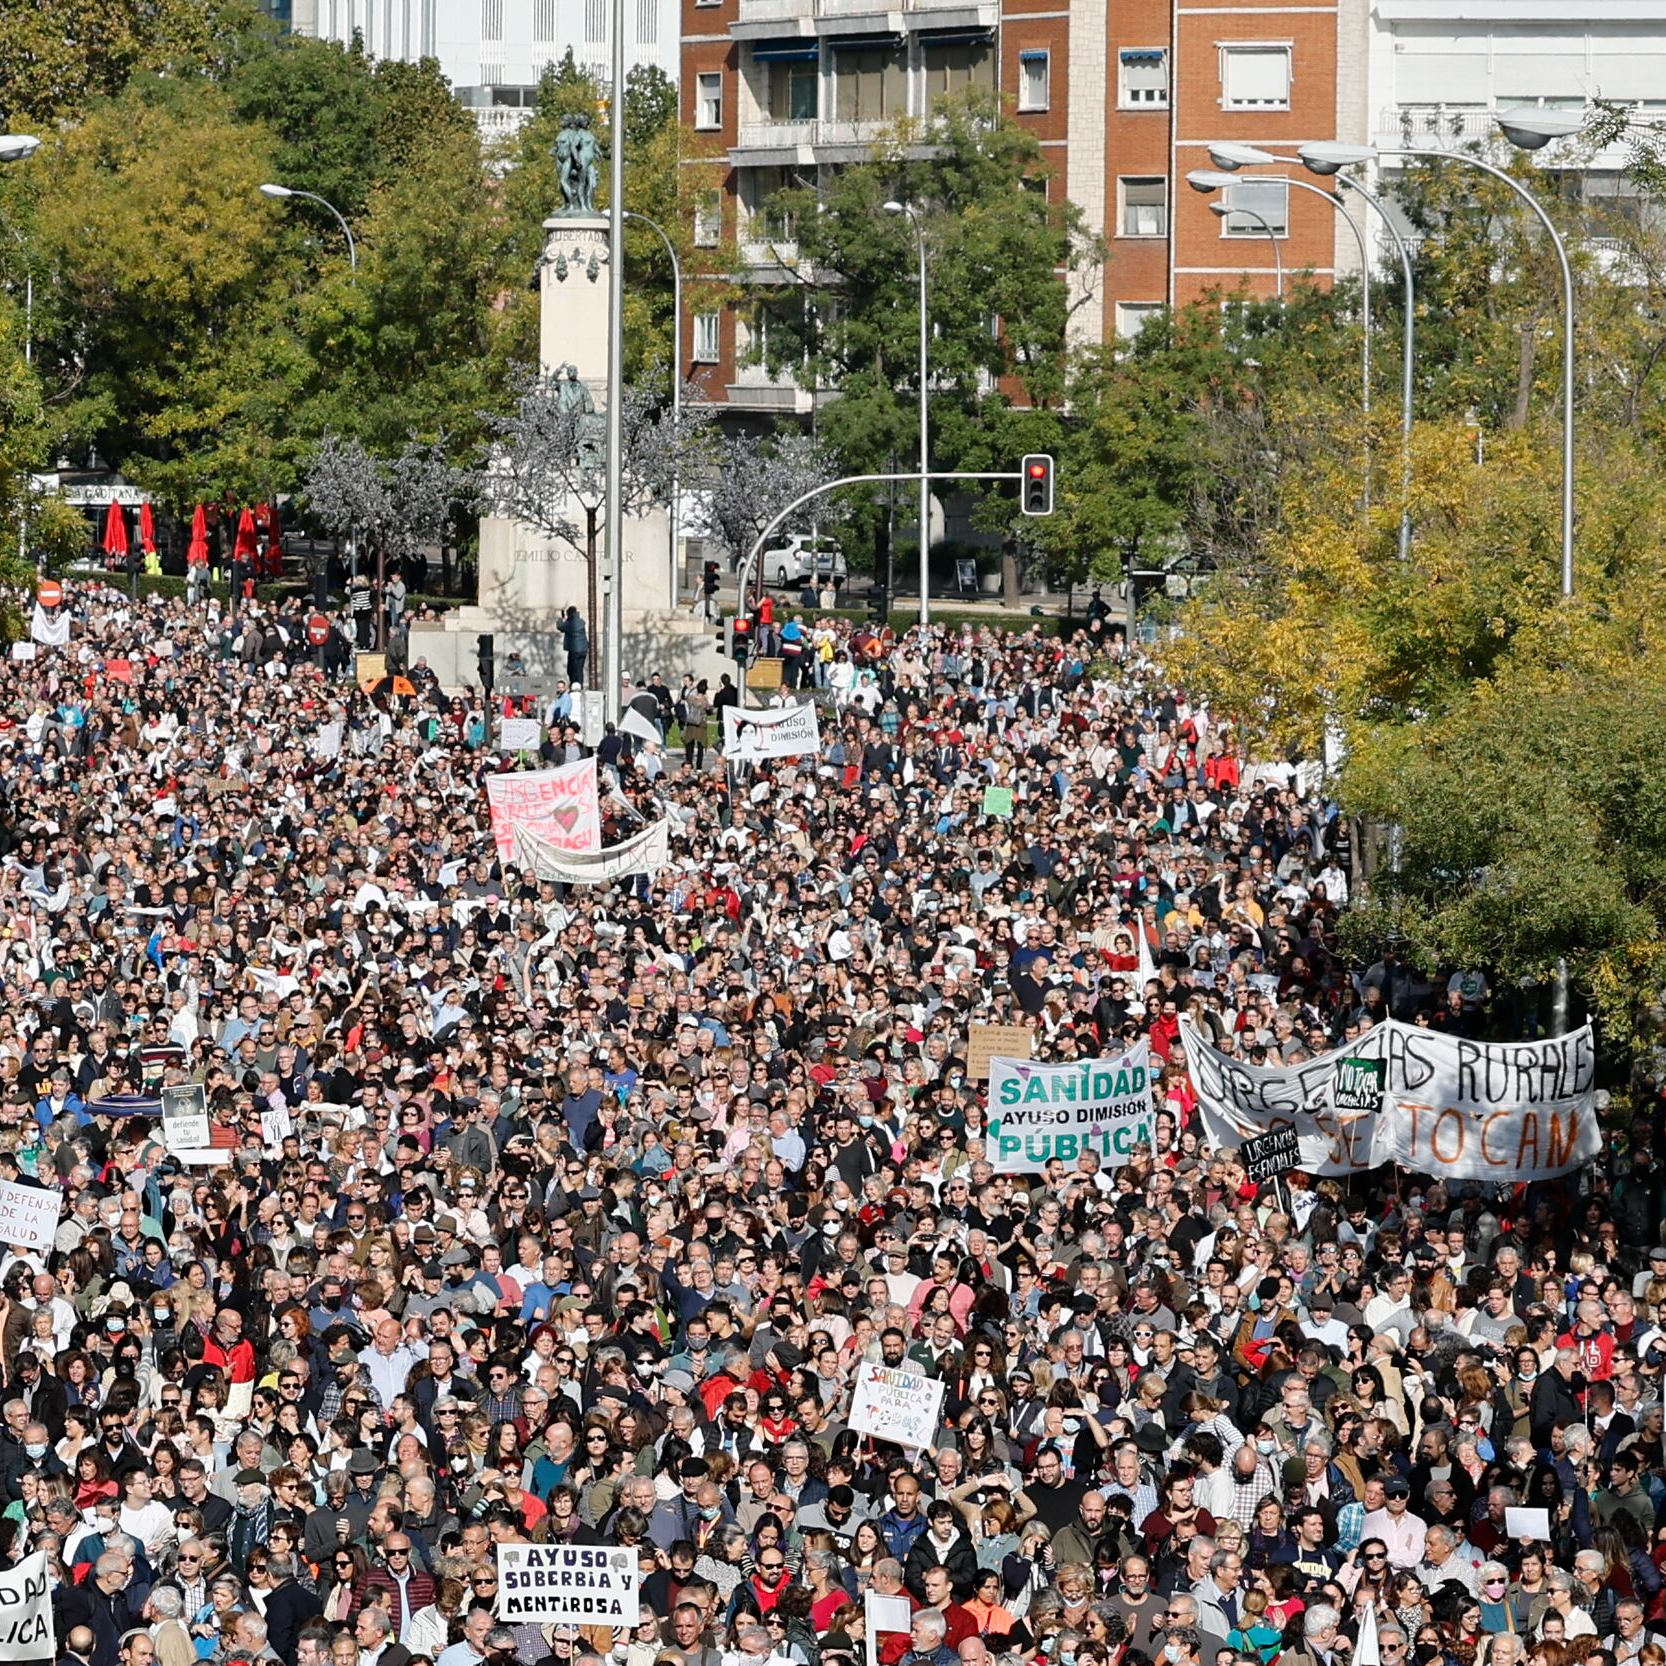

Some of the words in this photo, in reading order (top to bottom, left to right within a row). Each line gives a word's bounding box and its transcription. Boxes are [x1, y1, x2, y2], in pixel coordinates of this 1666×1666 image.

[515, 551, 560, 562] EMILIO
[771, 728, 813, 742] DIMISIÓN
[999, 1065, 1147, 1106] SANIDAD
[1001, 1109, 1071, 1126] AYUSO
[1076, 1099, 1147, 1125] DIMISIÓN
[173, 1119, 200, 1129] defiende
[183, 1128, 191, 1136] tu
[176, 1135, 200, 1144] sanidad
[999, 1116, 1152, 1163] PÚBLICA
[1245, 1128, 1298, 1162] URGENCIAS
[1248, 1146, 1301, 1184] ESENCIALES
[6, 1191, 58, 1214] DEFENSA
[2, 1205, 16, 1219] DE
[25, 1211, 39, 1225] LA
[868, 1366, 924, 1392] SANIDAD
[880, 1395, 912, 1411] PARA
[527, 1548, 608, 1568] AYUSO
